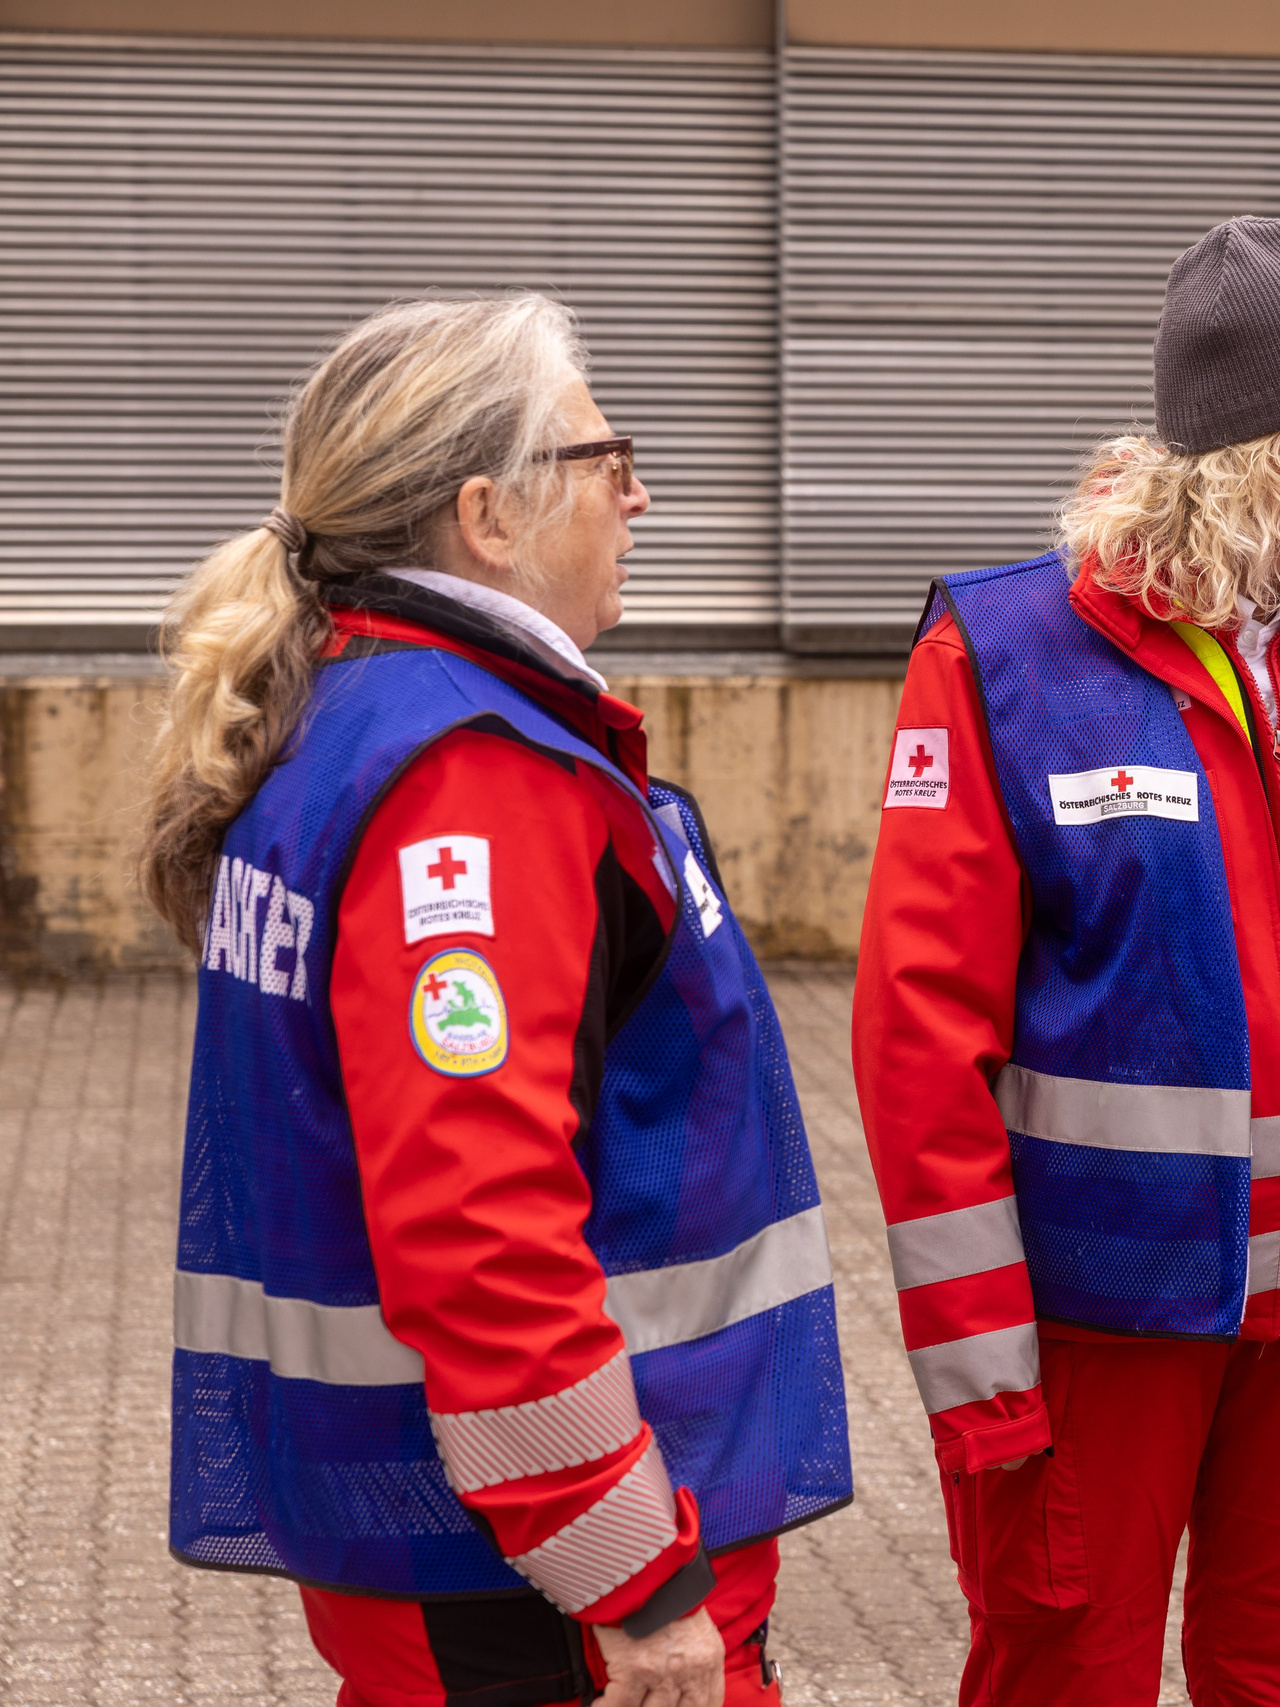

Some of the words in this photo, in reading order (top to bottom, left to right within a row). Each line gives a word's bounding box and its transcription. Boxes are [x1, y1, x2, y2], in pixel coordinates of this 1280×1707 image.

[889, 779, 947, 789] ÖSTERREICHISCHES
[894, 789, 913, 797] ROTES
[913, 789, 937, 798] KREUZ
[1059, 791, 1132, 810] ÖSTERREICHISCHES
[1136, 791, 1163, 802] ROTES
[1165, 795, 1192, 806] KREUZ
[1103, 801, 1145, 813] SALZBURG
